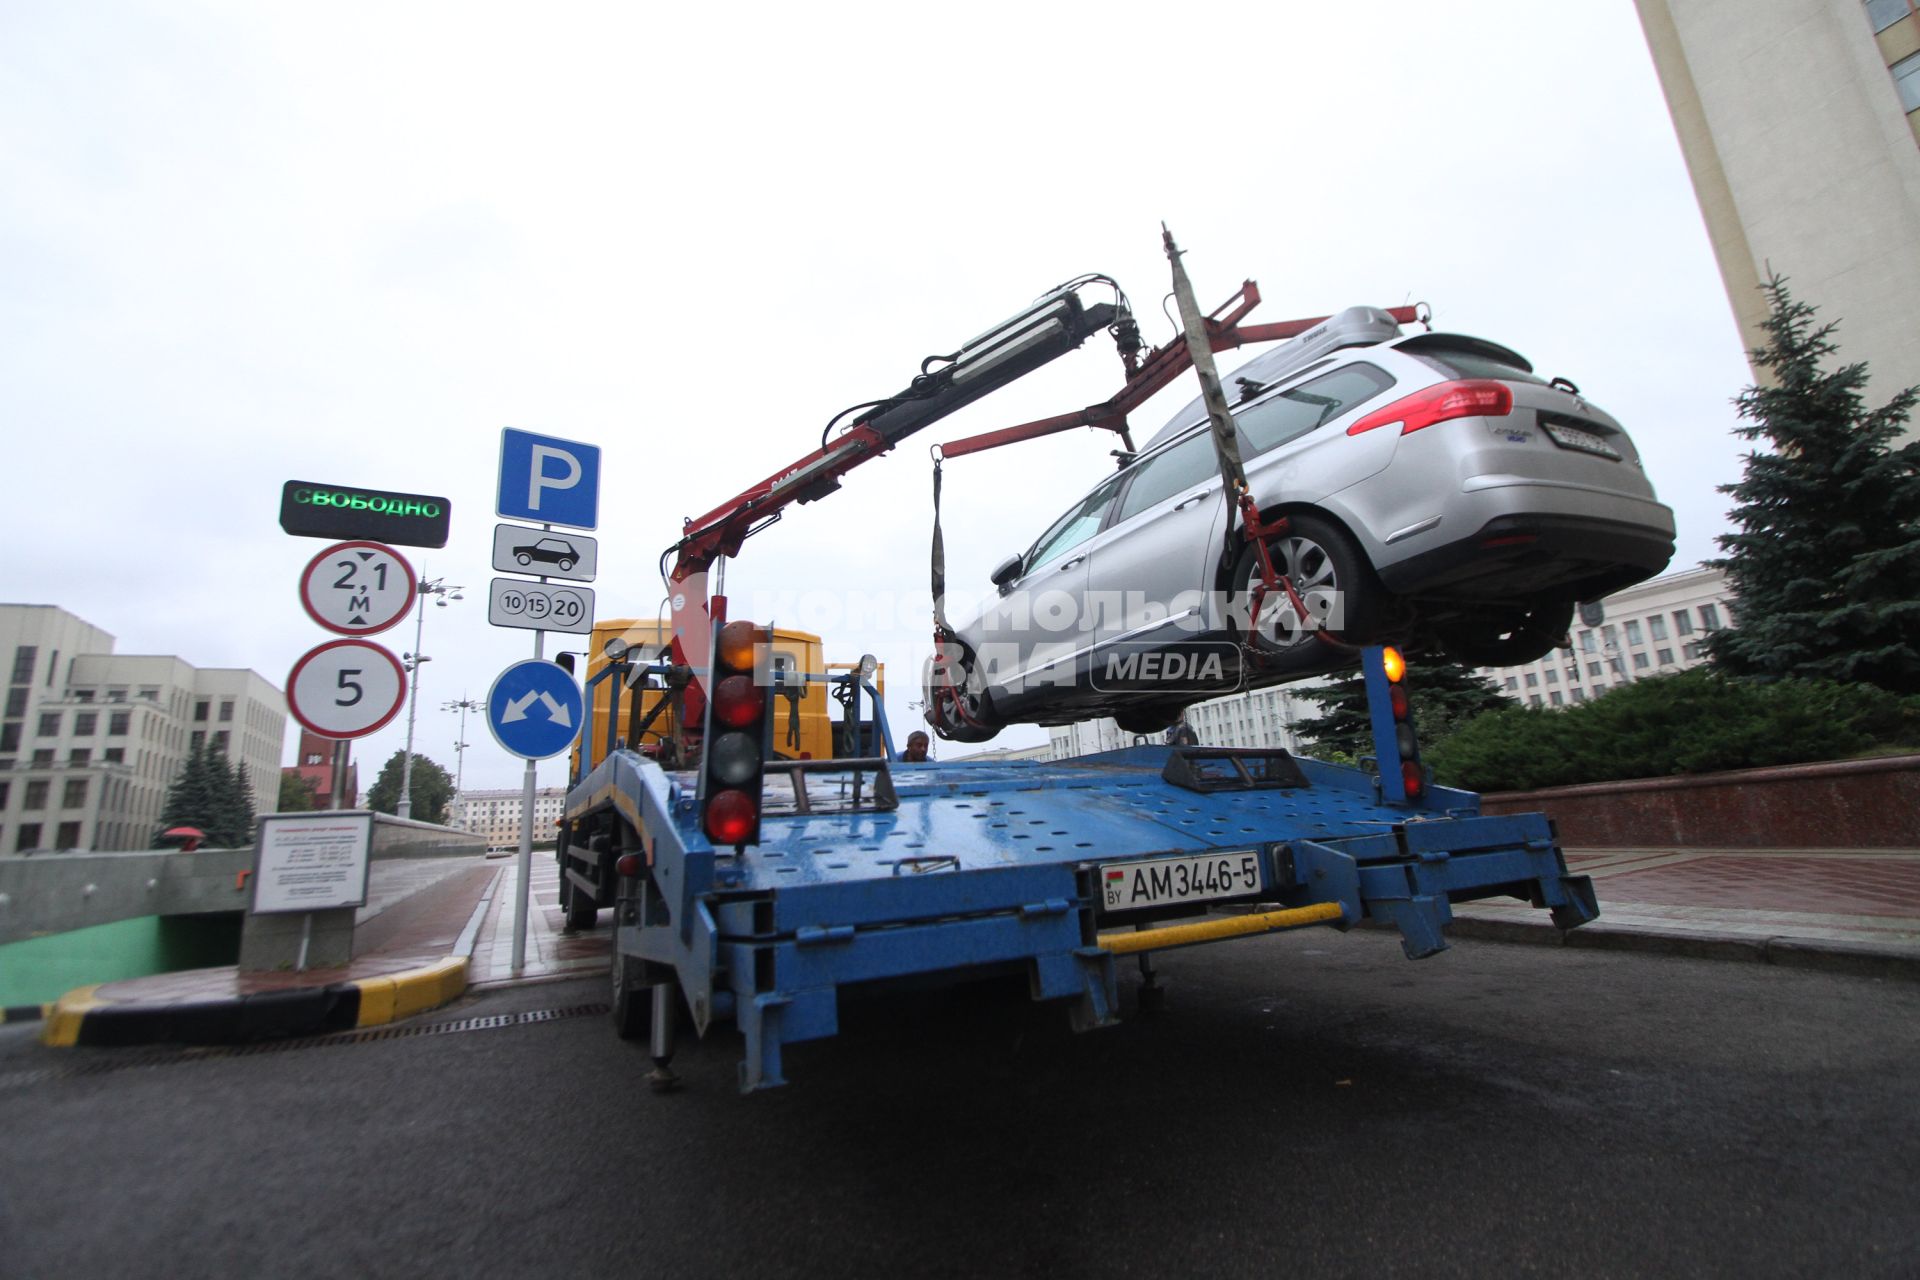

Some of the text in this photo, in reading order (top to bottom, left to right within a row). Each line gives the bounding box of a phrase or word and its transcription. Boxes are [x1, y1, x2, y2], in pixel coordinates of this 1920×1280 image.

[528, 444, 582, 511] P
[293, 488, 440, 518] СВОБОДНО
[333, 560, 388, 593] 2,1
[504, 596, 578, 617] 10 15 20
[335, 669, 363, 707] 5
[1107, 890, 1122, 905] BY
